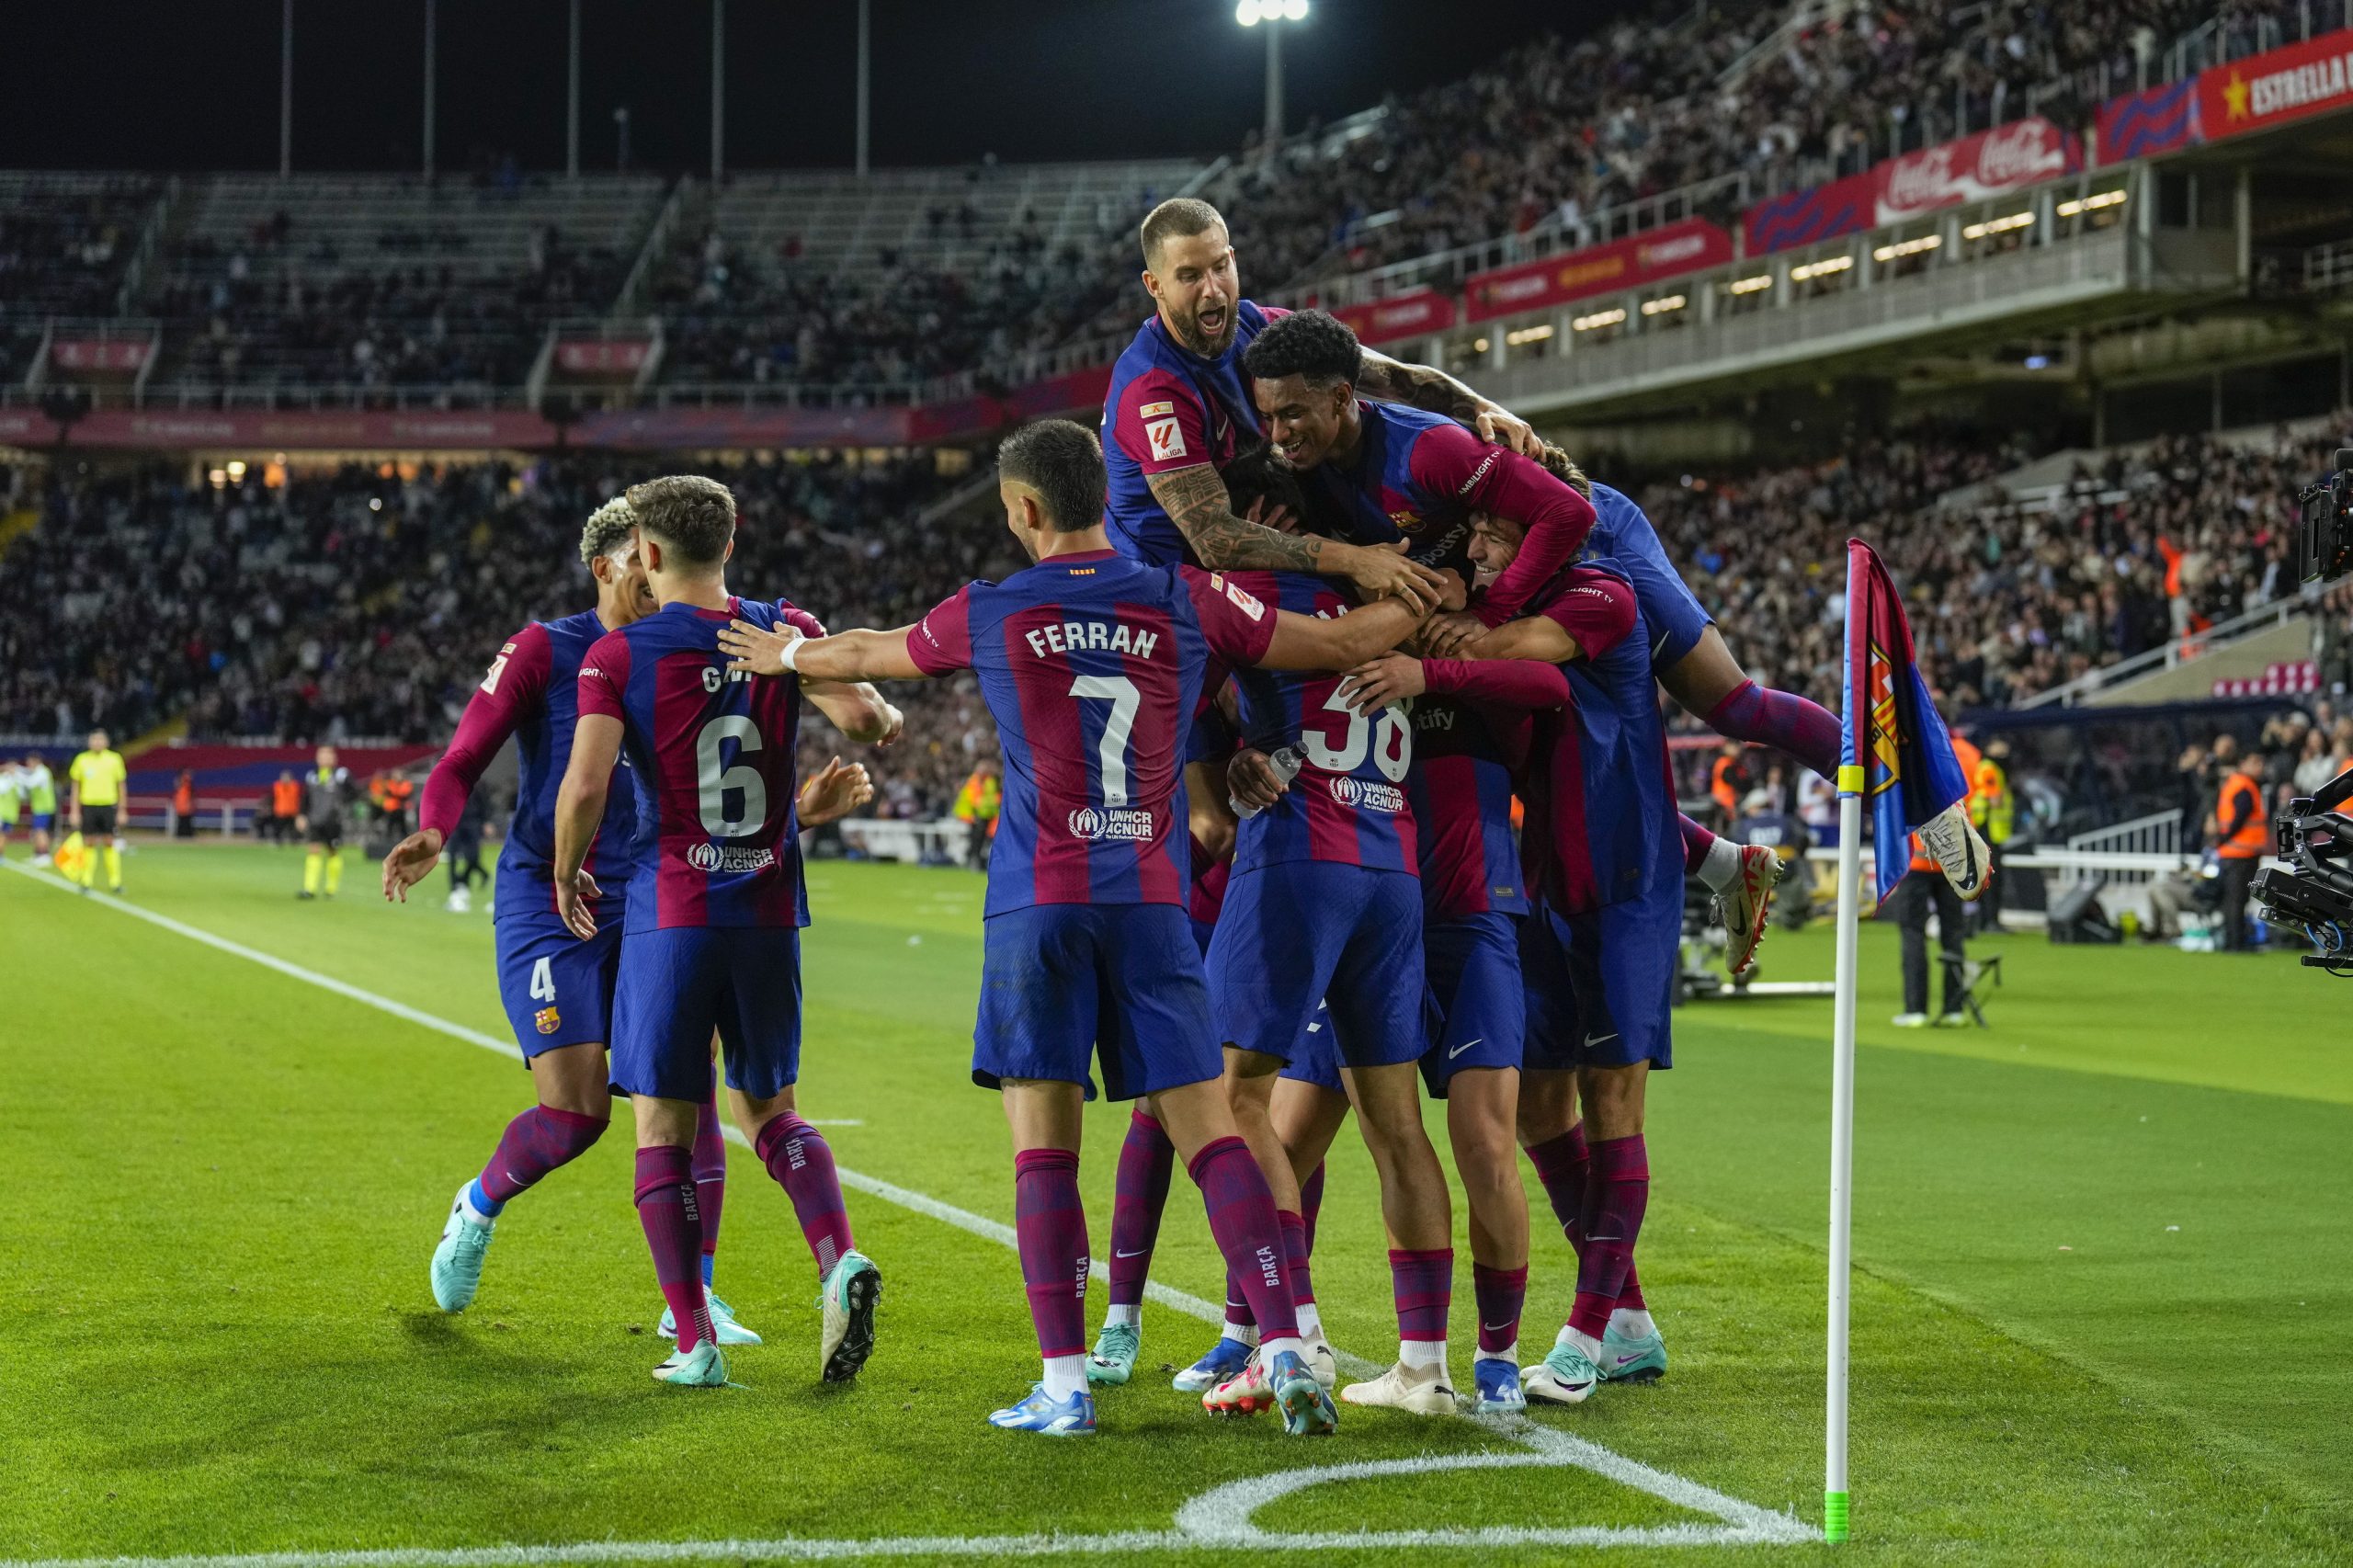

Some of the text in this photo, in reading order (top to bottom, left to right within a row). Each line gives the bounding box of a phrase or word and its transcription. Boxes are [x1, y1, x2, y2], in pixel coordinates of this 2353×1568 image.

[2251, 55, 2345, 117] ESTRELLA
[1158, 449, 1182, 460] LALIGA
[1458, 458, 1494, 495] AMBILIGHT
[1026, 622, 1158, 659] FERRAN
[1415, 708, 1455, 731] tify
[1068, 675, 1140, 807] 7
[697, 715, 767, 837] 6
[1362, 781, 1403, 799] UNHCR
[1108, 810, 1153, 824] UNHCR
[1363, 792, 1403, 811] ACNUR
[1106, 823, 1153, 836] ACNUR
[529, 956, 556, 1002] 4
[1075, 1256, 1087, 1298] BARÇA
[1256, 1245, 1280, 1287] BARÇA
